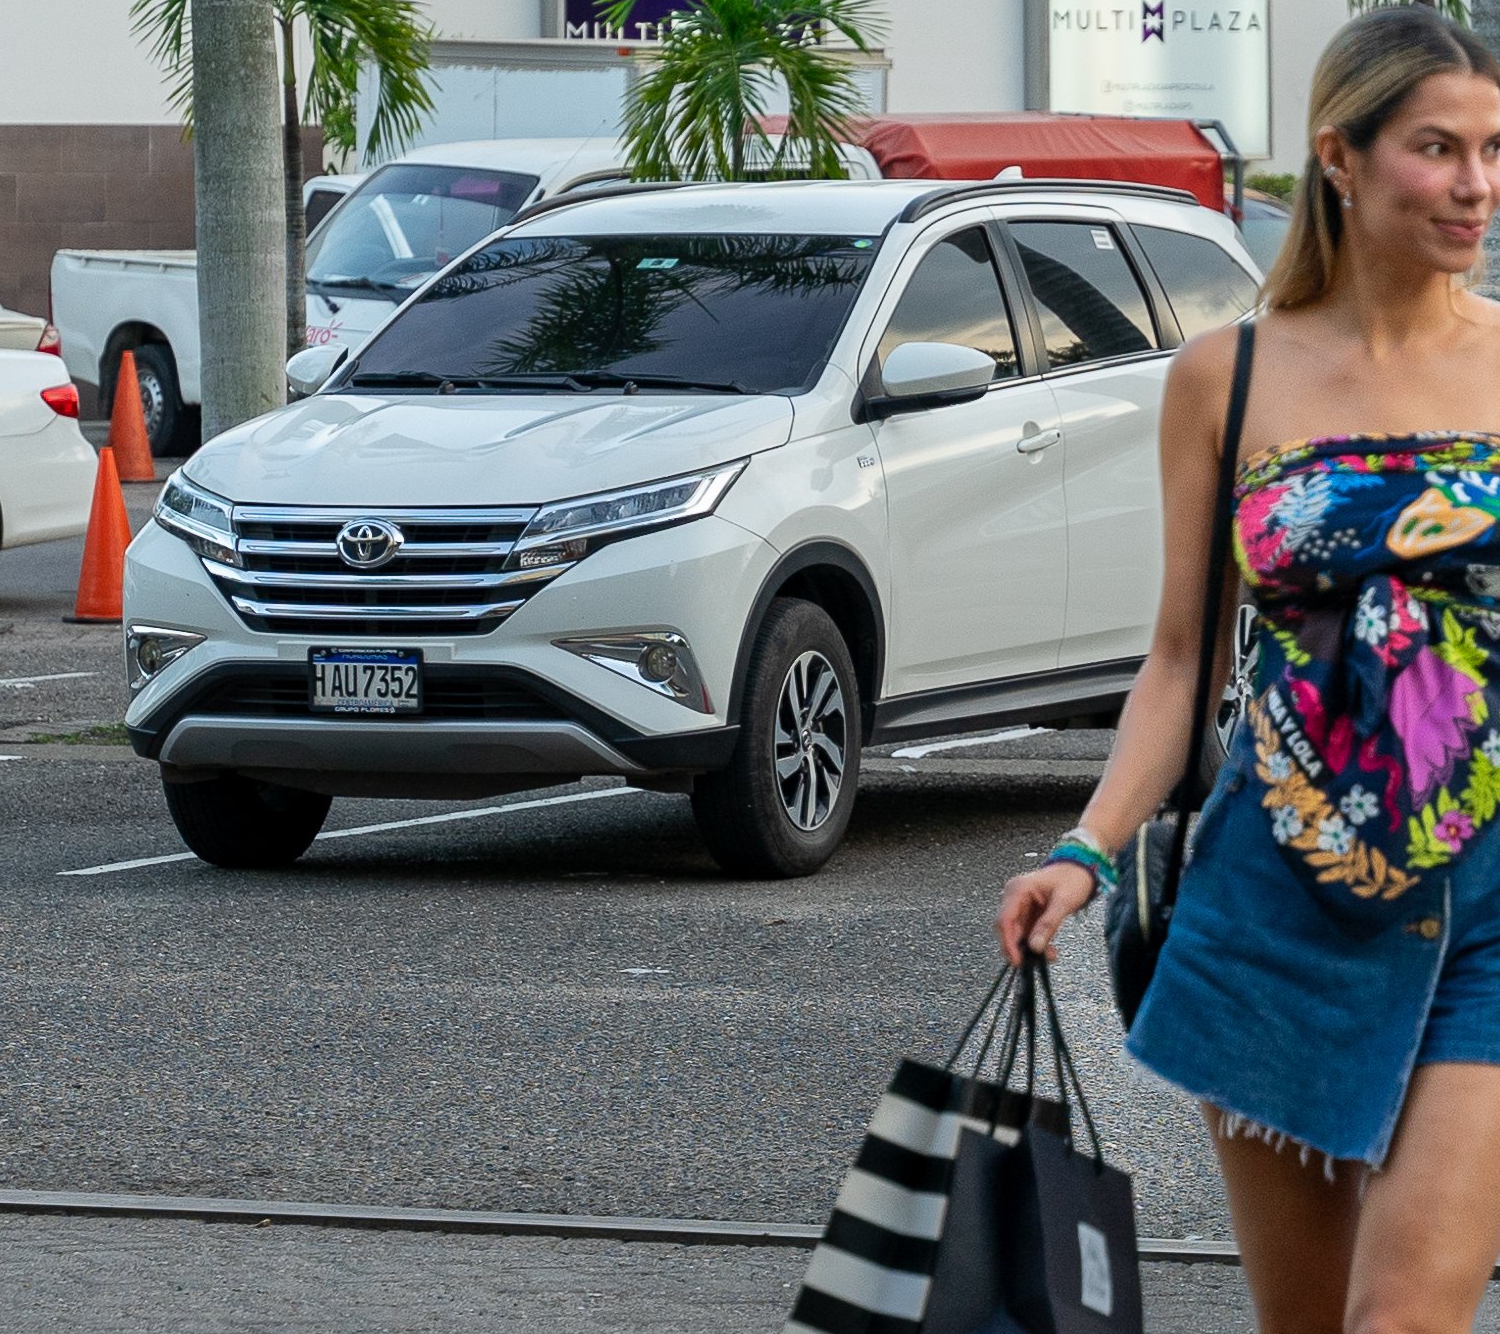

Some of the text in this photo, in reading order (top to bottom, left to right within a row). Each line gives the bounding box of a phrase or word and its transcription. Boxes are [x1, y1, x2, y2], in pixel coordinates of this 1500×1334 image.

[1053, 10, 1263, 32] MULTI PLAZA
[1286, 730, 1323, 779] LOLA
